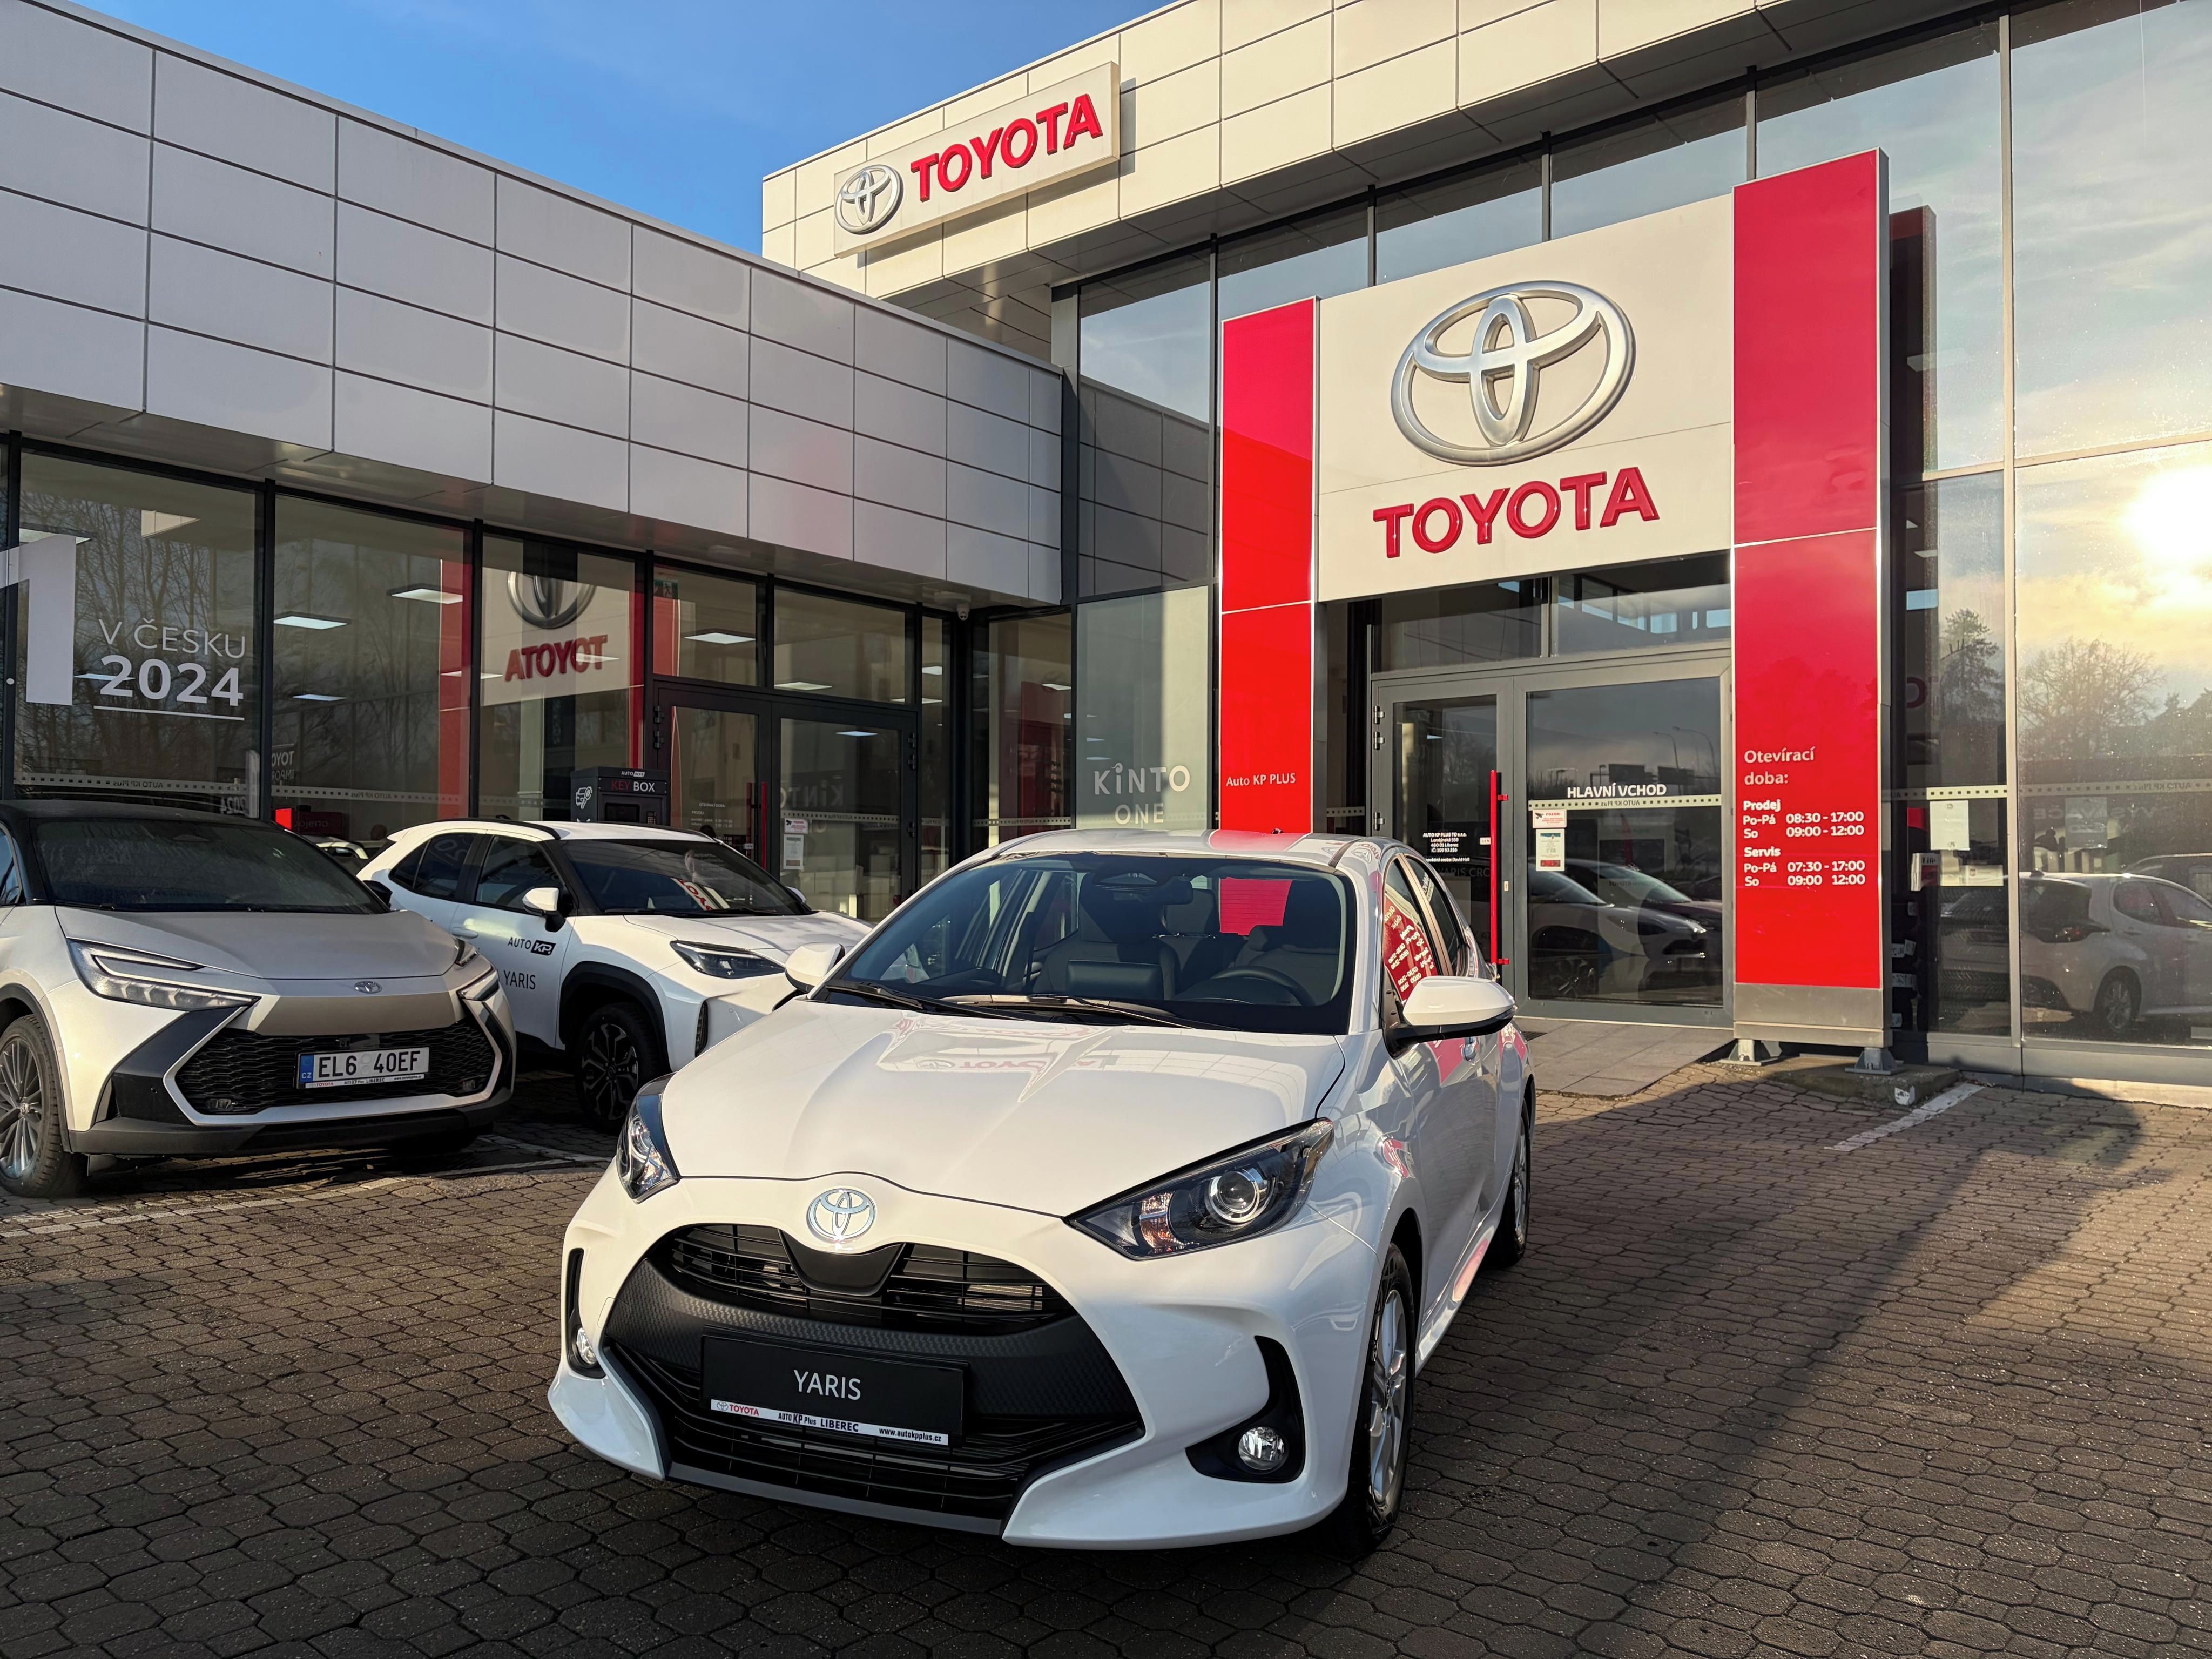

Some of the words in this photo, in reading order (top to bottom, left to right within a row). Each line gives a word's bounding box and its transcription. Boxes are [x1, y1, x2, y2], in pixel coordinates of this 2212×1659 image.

[911, 93, 1103, 203] TOYOTA
[1373, 467, 1660, 558] TOYOTA
[99, 619, 122, 645] V
[134, 618, 245, 658] ČESKU
[100, 655, 243, 706] 2024
[1744, 746, 1816, 763] Otevírací
[612, 780, 630, 791] KEY
[633, 781, 655, 792] BOX
[1226, 777, 1250, 786] Auto
[1253, 774, 1267, 785] KP
[1270, 773, 1296, 784] PLUS
[1744, 771, 1789, 785] doba:
[1567, 782, 1616, 798] HLAVNÍ
[1618, 784, 1667, 797] VCHOD
[1743, 799, 1781, 812] Prodej
[1115, 803, 1164, 825] ONE
[1743, 814, 1776, 825] Po-Pá
[1786, 813, 1821, 824] 08:30
[1831, 811, 1864, 822] 17:00
[1744, 828, 1758, 839] So
[1786, 826, 1822, 837] 09:00
[1831, 825, 1864, 836] 12:00
[1744, 846, 1781, 858] Servis
[1744, 862, 1777, 873] Po-Pá
[1788, 861, 1822, 873] 07:30
[1832, 860, 1865, 871] 17:00
[1745, 876, 1759, 887] So
[1788, 875, 1822, 886] 09:00
[1832, 874, 1865, 885] 12:00
[508, 936, 531, 949] AUTO
[503, 970, 536, 990] YARIS
[319, 1055, 357, 1078] EL6
[374, 1050, 420, 1073] 40EF
[794, 1370, 861, 1400] YARIS
[730, 1404, 759, 1417] TOYOTA
[778, 1412, 792, 1421] AUTO
[793, 1413, 802, 1424] KP
[804, 1416, 817, 1425] Plus
[820, 1418, 859, 1432] LIBEREC
[879, 1428, 941, 1442] www.autokpplus.cz
